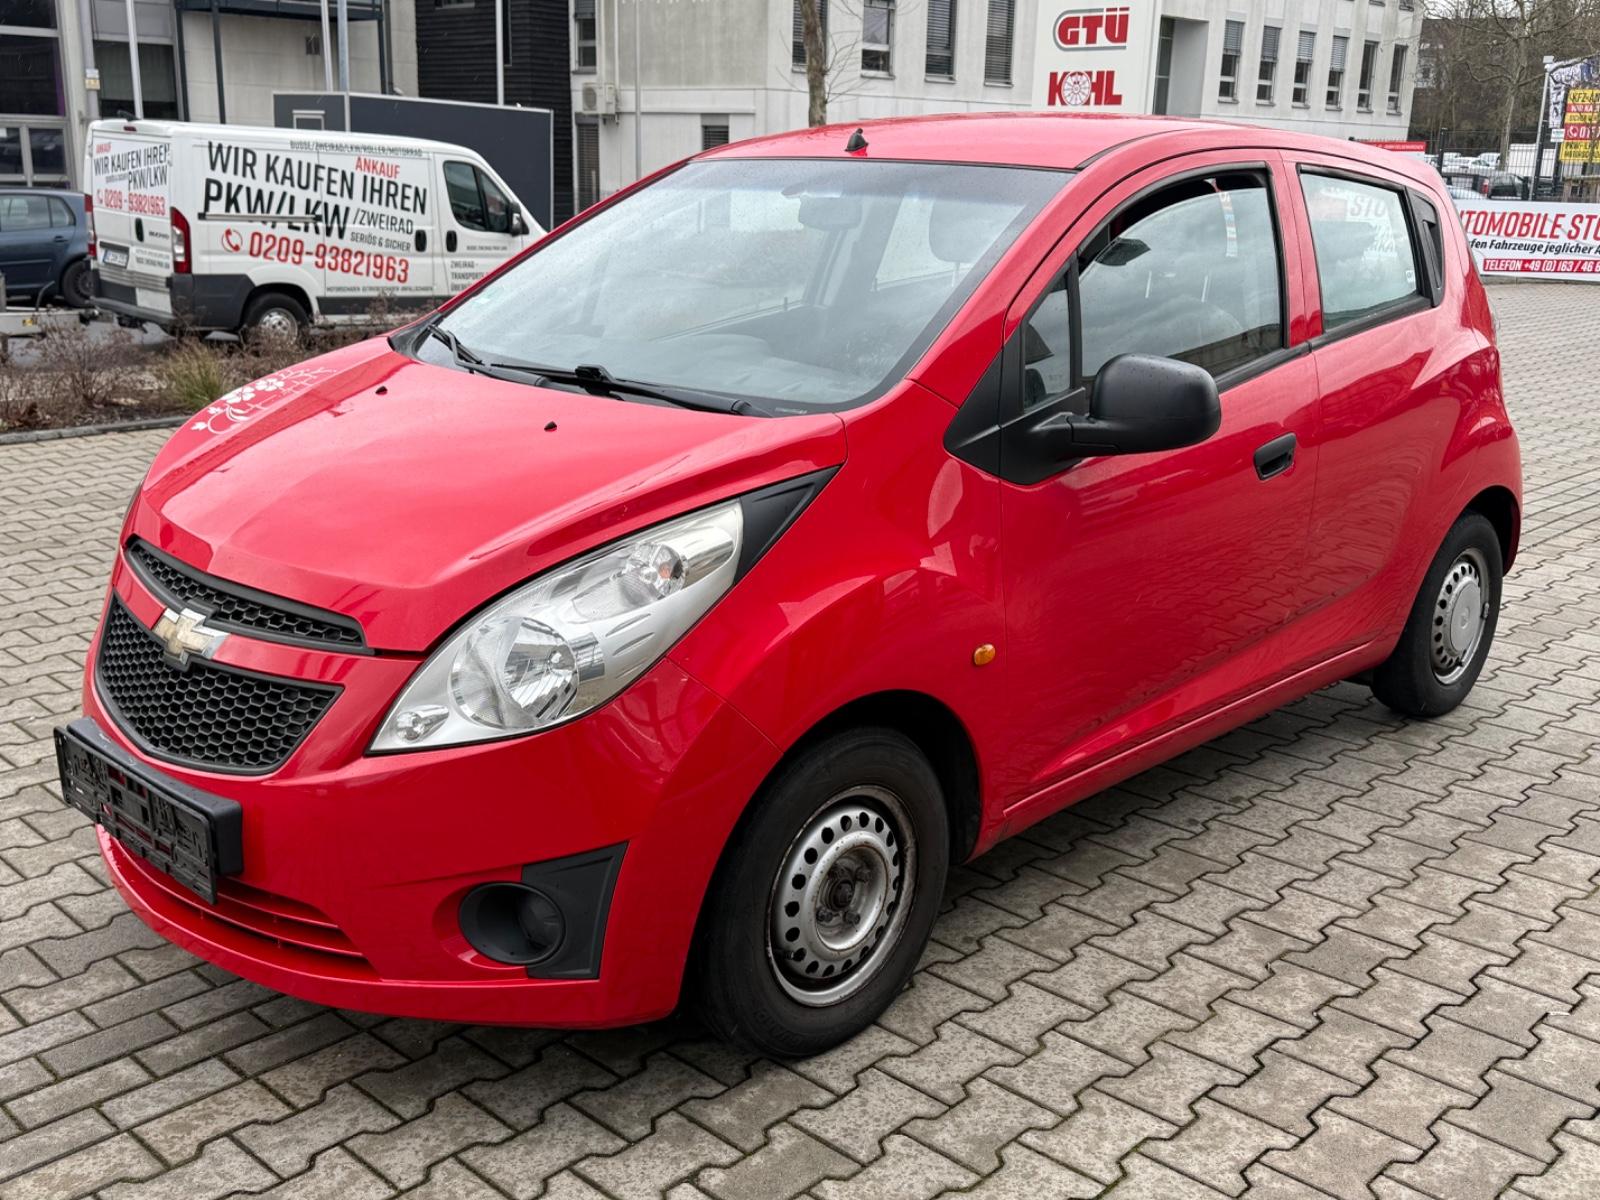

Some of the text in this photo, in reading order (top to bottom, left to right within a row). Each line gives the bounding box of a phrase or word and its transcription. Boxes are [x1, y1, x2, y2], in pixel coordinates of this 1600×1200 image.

[1057, 7, 1129, 45] GTÜ
[1047, 70, 1123, 106] KOHL
[94, 156, 110, 176] WIR
[110, 149, 142, 175] KAUFEN
[355, 156, 401, 179] ANKAUF
[128, 166, 168, 192] PKW/LKW
[208, 141, 428, 215] WIR KAUFEN IHREN
[104, 188, 123, 209] 0209
[128, 192, 166, 216] 93821963
[203, 178, 350, 240] PKW/LKW
[350, 231, 377, 246] SERIÖS
[384, 238, 412, 252] SICHER
[1488, 240, 1543, 254] Fahrzeuge
[1543, 242, 1593, 255] jeglicher
[249, 231, 410, 284] 0209-93821963
[1484, 259, 1521, 271] TELEFON
[1523, 261, 1541, 271] +49
